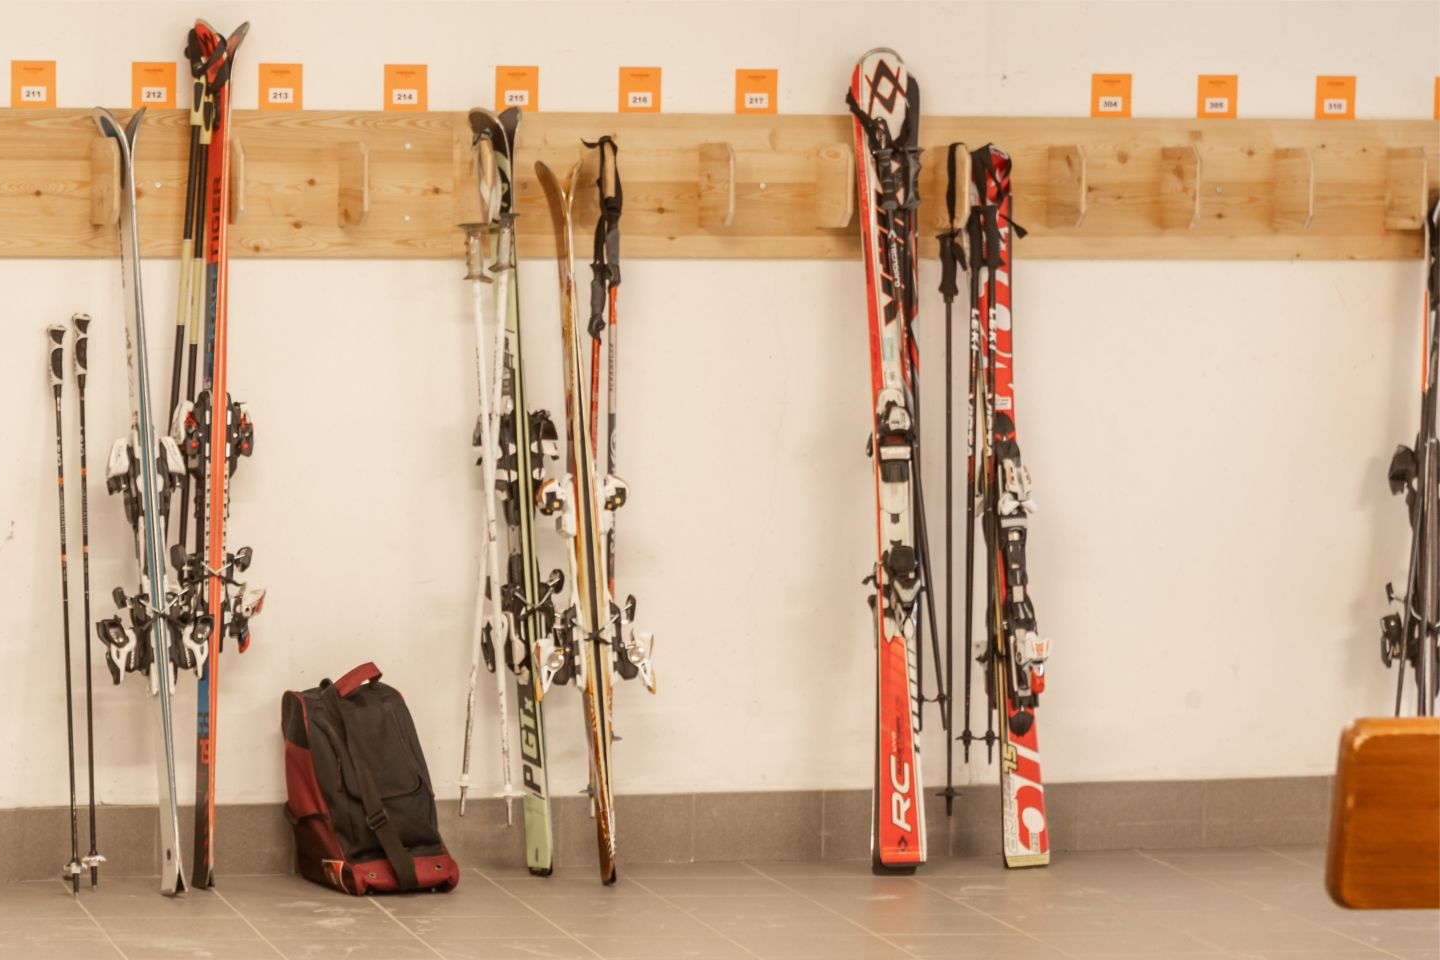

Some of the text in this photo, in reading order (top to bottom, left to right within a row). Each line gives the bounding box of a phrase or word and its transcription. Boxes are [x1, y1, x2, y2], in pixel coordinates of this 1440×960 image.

[24, 89, 42, 98] 211
[145, 90, 163, 99] 212
[272, 91, 289, 100] 213
[396, 92, 413, 101] 214
[508, 94, 525, 103] 215
[632, 95, 648, 104] 216
[748, 96, 764, 105] 217
[210, 176, 221, 256] TIGER
[971, 308, 980, 351] LEKI
[988, 307, 998, 351] LEKI
[890, 754, 912, 832] RC
